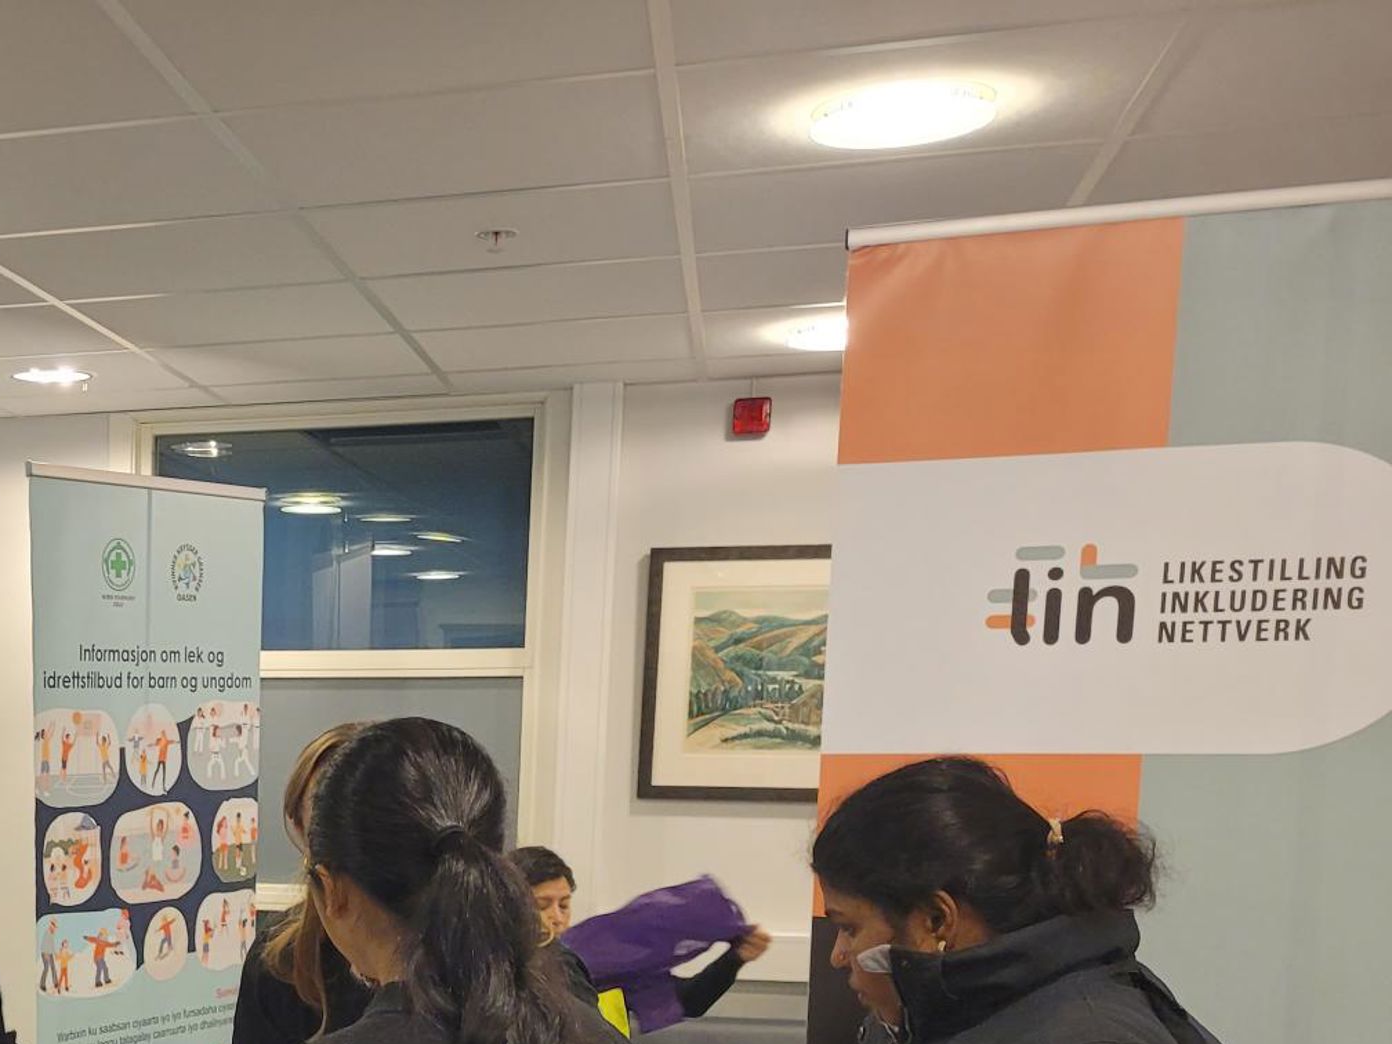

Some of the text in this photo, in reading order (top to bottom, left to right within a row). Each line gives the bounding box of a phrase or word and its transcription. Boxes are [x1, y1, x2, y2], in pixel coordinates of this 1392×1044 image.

[1162, 556, 1369, 584] LIKESTILLING
[1010, 566, 1136, 646] lin
[1159, 586, 1366, 614] INKLUDERING
[1158, 618, 1312, 644] NETTVERK
[79, 644, 225, 667] Informasjon om lek og
[43, 671, 253, 692] idrettstilbud for barn og ungdom
